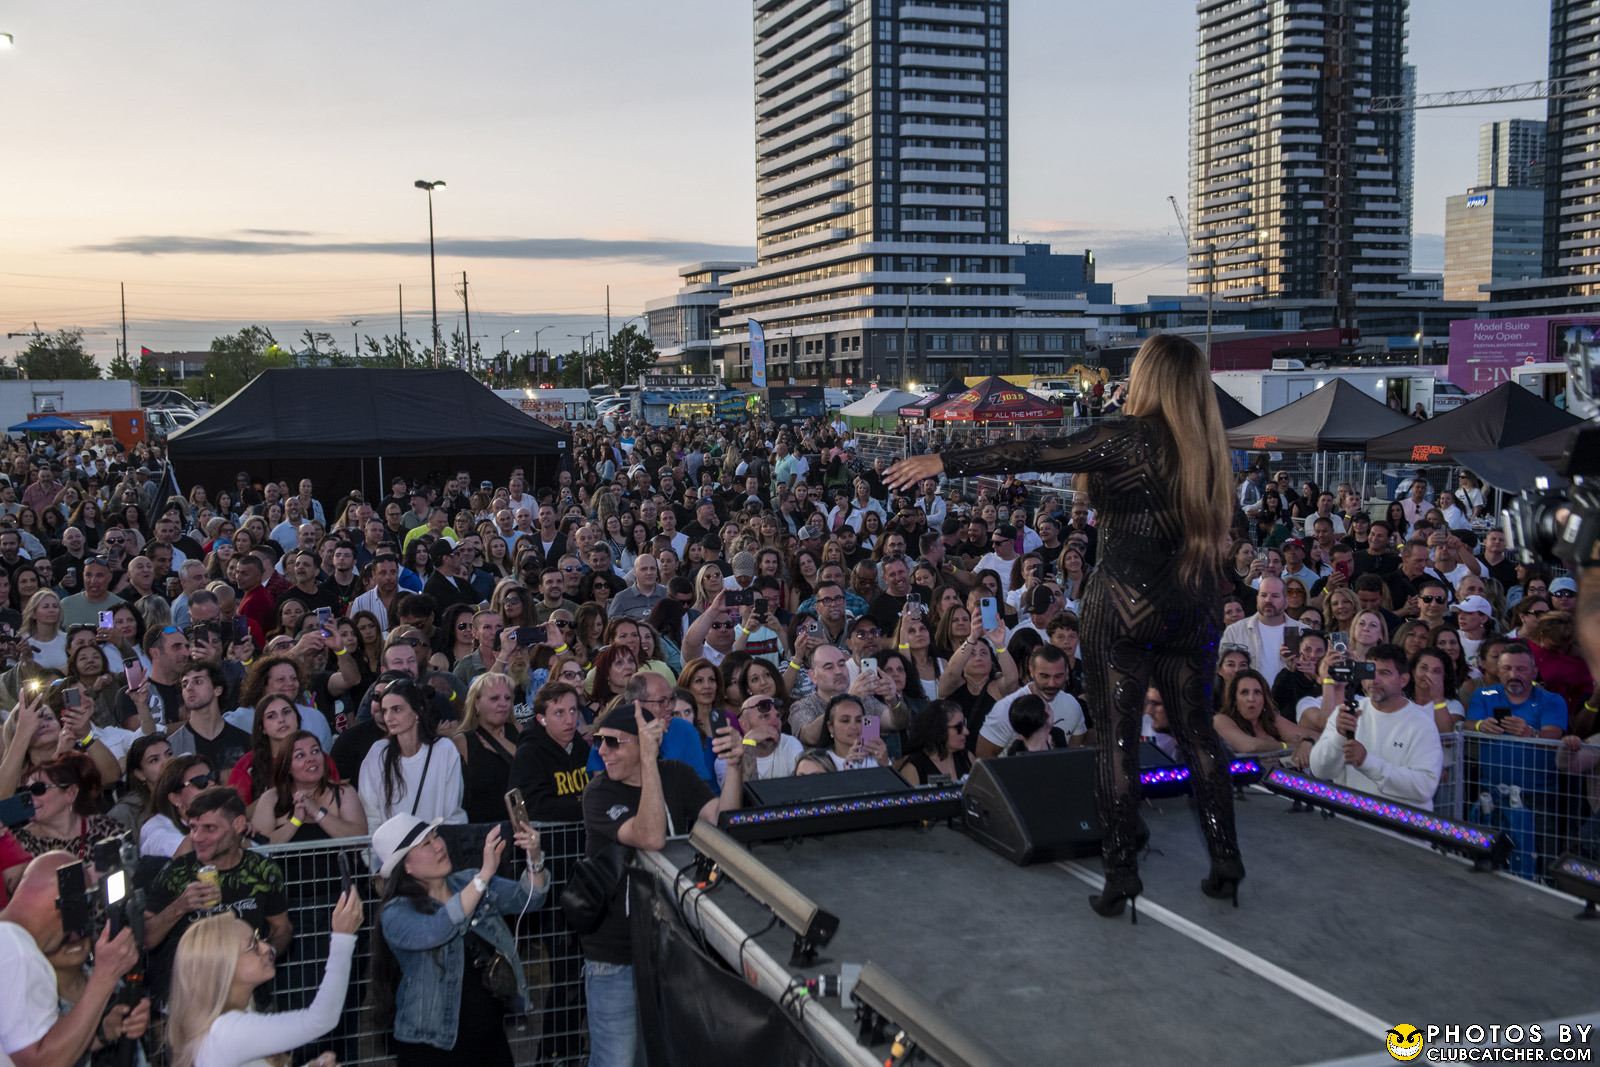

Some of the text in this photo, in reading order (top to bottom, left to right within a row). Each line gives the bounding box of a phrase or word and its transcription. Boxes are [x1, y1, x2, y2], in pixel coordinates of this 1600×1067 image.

[1474, 322, 1530, 331] Model Suite
[1474, 332, 1522, 341] Now Open
[1412, 453, 1429, 462] PARK
